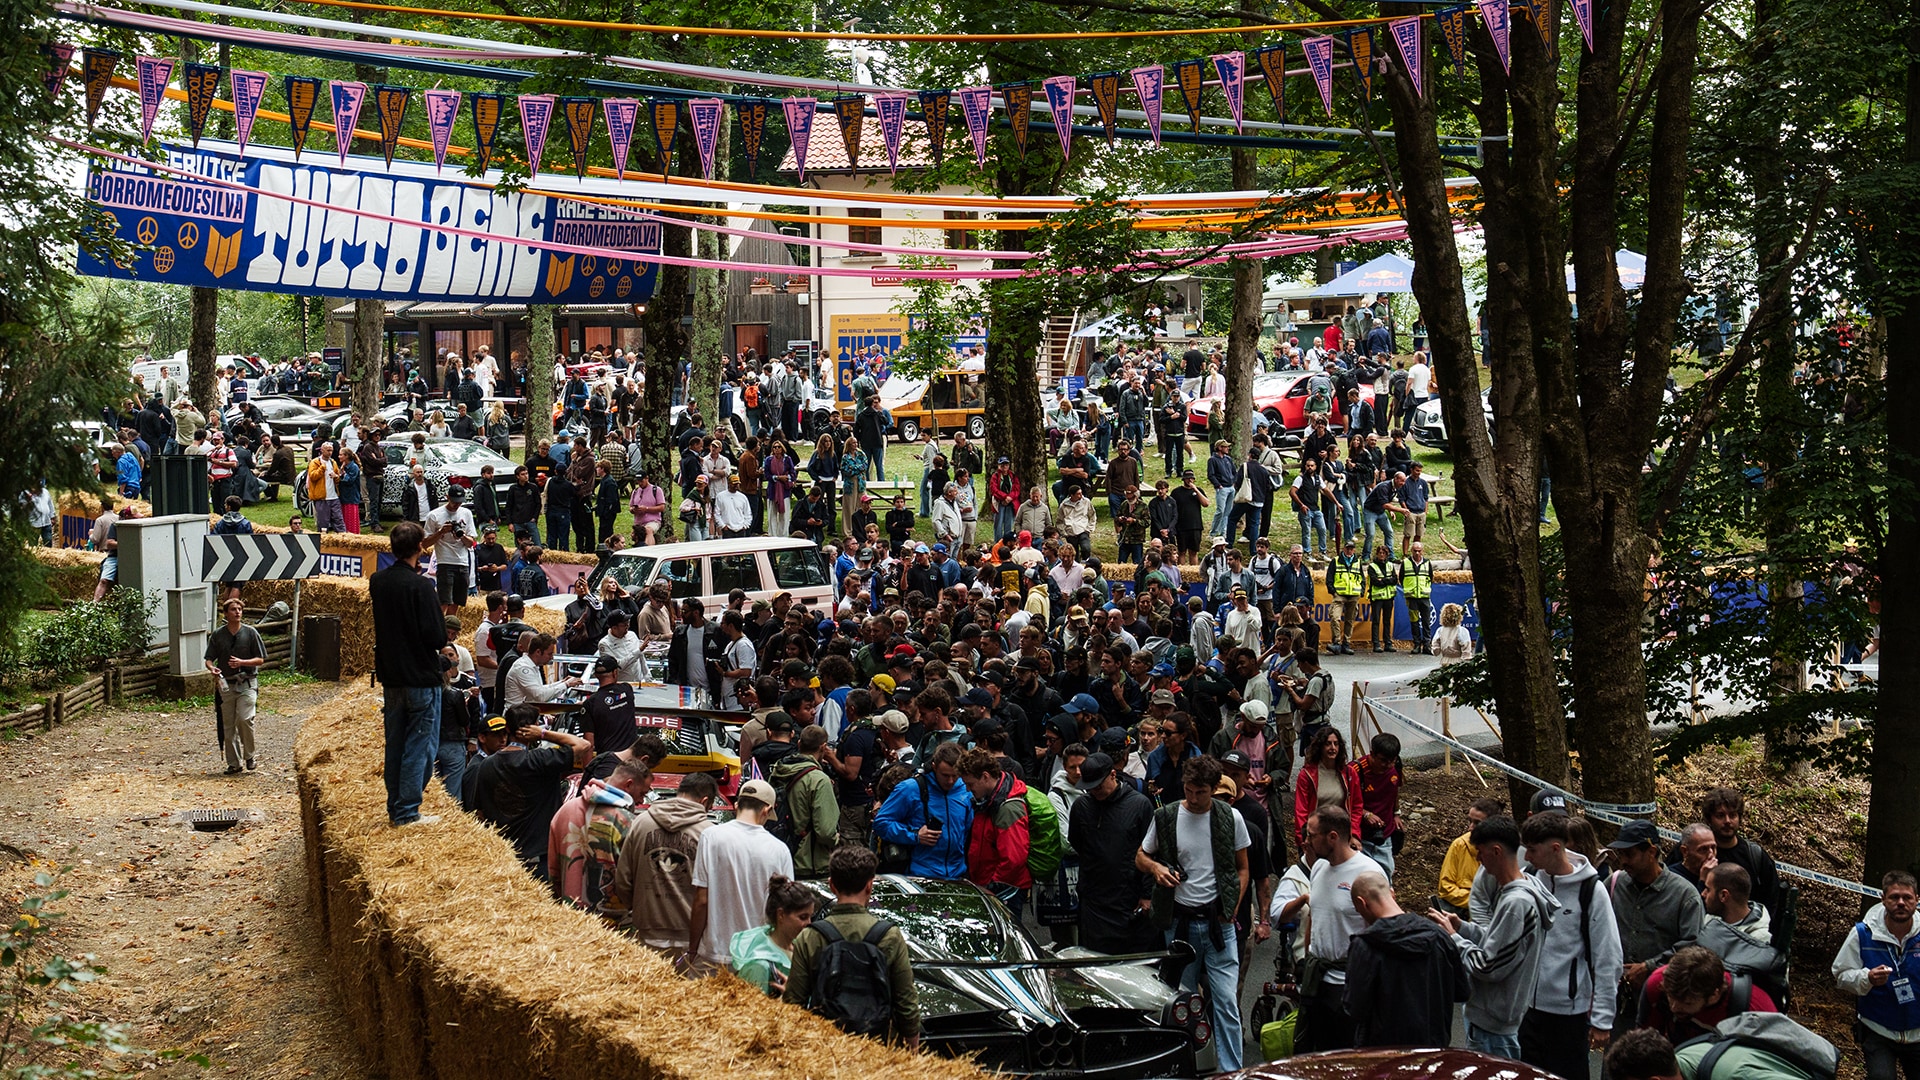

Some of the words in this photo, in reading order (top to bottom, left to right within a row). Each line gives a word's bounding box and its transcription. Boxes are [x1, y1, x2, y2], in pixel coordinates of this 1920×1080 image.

[1451, 11, 1462, 36] SLOW
[91, 58, 113, 100] STAZIONE
[203, 71, 217, 97] SLOW
[197, 97, 210, 128] DOWN
[753, 106, 765, 131] SLOW
[935, 95, 947, 120] SLOW
[1014, 88, 1029, 131] STAZIONE
[848, 101, 861, 144] STAZIONE
[91, 174, 243, 219] BORROMEODESILVA
[418, 184, 547, 298] BENE
[554, 222, 657, 248] BORROMEODESILVA
[1358, 279, 1382, 288] Red
[1383, 278, 1407, 288] Bull
